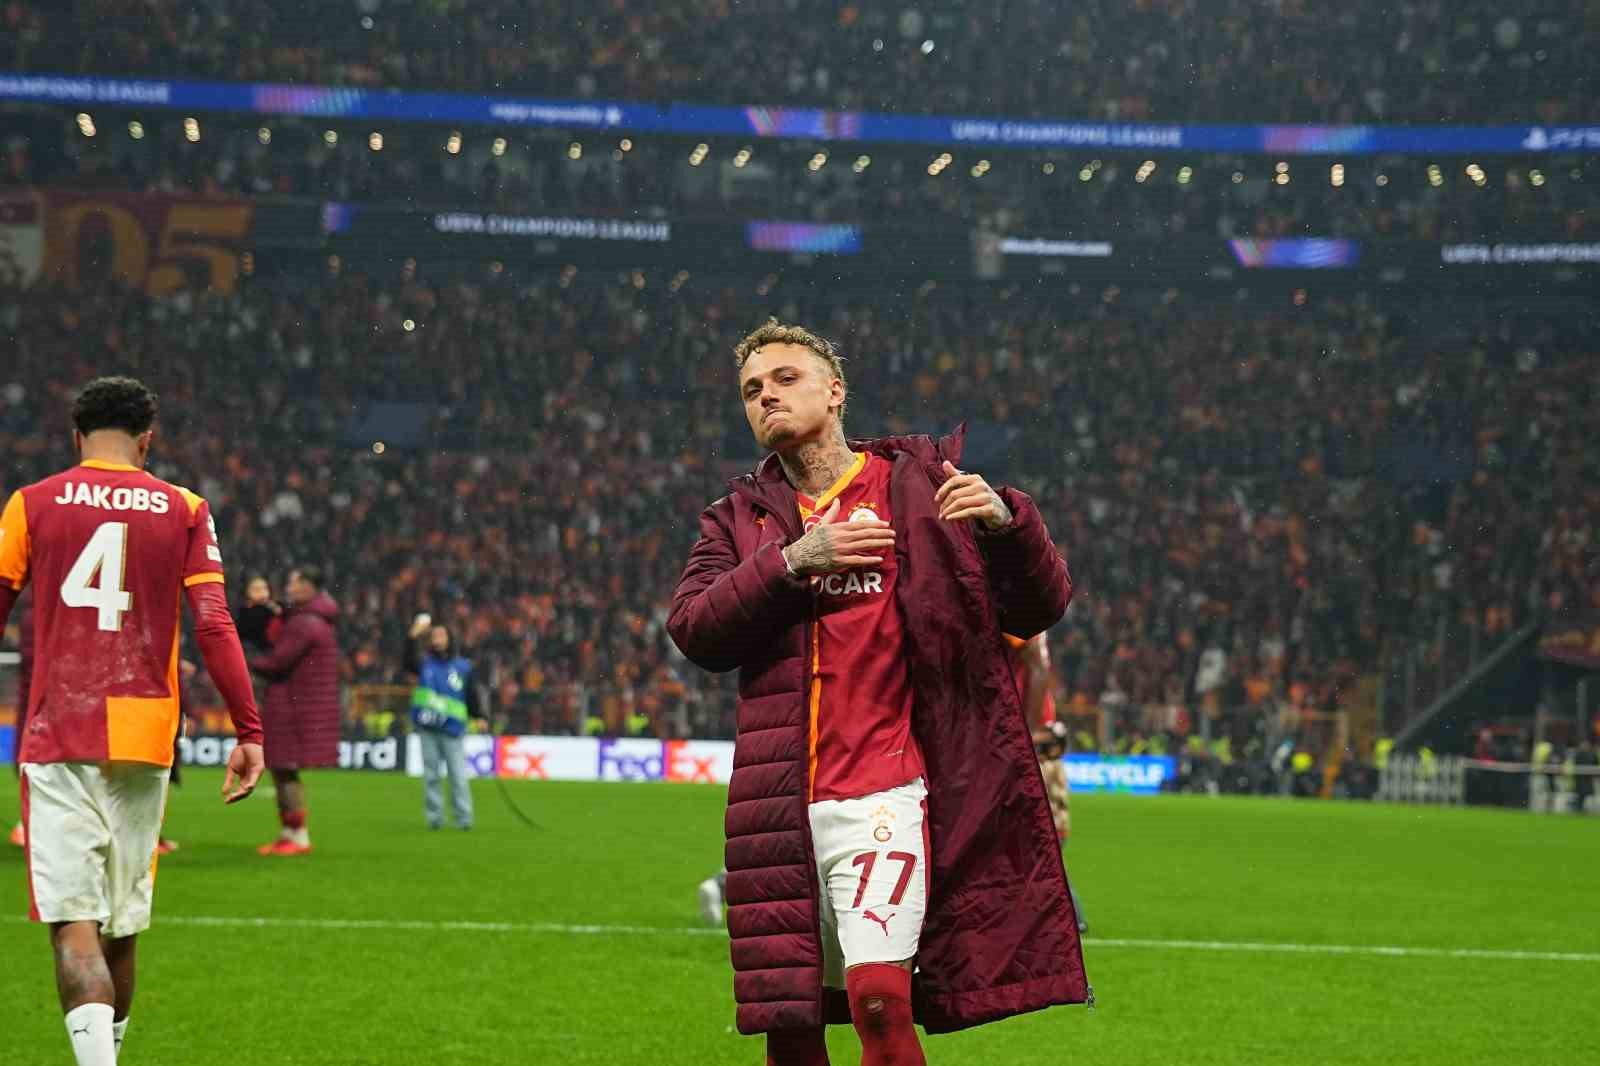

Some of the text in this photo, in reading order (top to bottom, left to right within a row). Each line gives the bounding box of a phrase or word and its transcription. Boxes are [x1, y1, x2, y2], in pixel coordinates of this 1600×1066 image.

[1001, 121, 1107, 144] CHAMPIONS
[1110, 125, 1182, 147] LEAGUE
[486, 214, 597, 239] CHAMPIONS
[598, 219, 671, 241] LEAGUE
[55, 481, 169, 514] JAKOBS
[60, 521, 133, 632] 4
[598, 736, 717, 784] FedEx
[851, 851, 919, 909] 17
